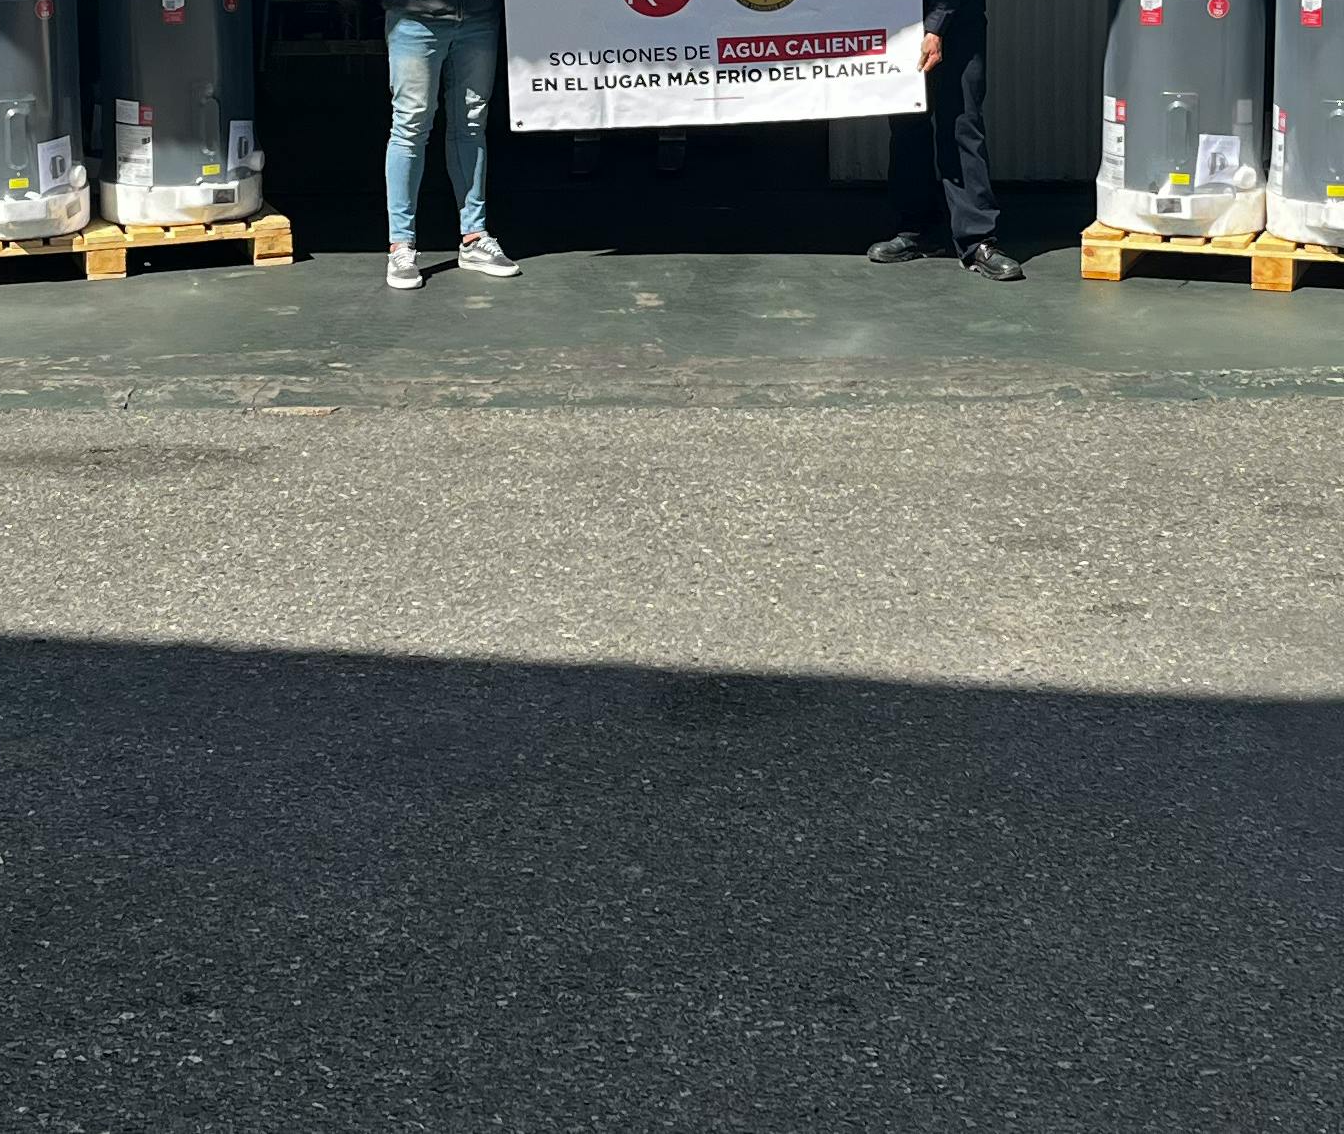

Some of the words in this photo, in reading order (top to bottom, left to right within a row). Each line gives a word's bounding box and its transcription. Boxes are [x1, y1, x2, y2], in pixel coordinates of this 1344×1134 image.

[549, 45, 678, 67] SOLUCIONES
[684, 45, 711, 61] DE
[722, 40, 779, 60] AGUA
[784, 34, 884, 57] CALIENTE
[532, 77, 558, 93] EN
[564, 76, 588, 92] EL
[593, 74, 661, 91] LUGAR
[667, 67, 709, 87] MÁS
[716, 66, 762, 85] FRÍO
[768, 67, 807, 82] DEL
[812, 61, 902, 79] PLANETA
